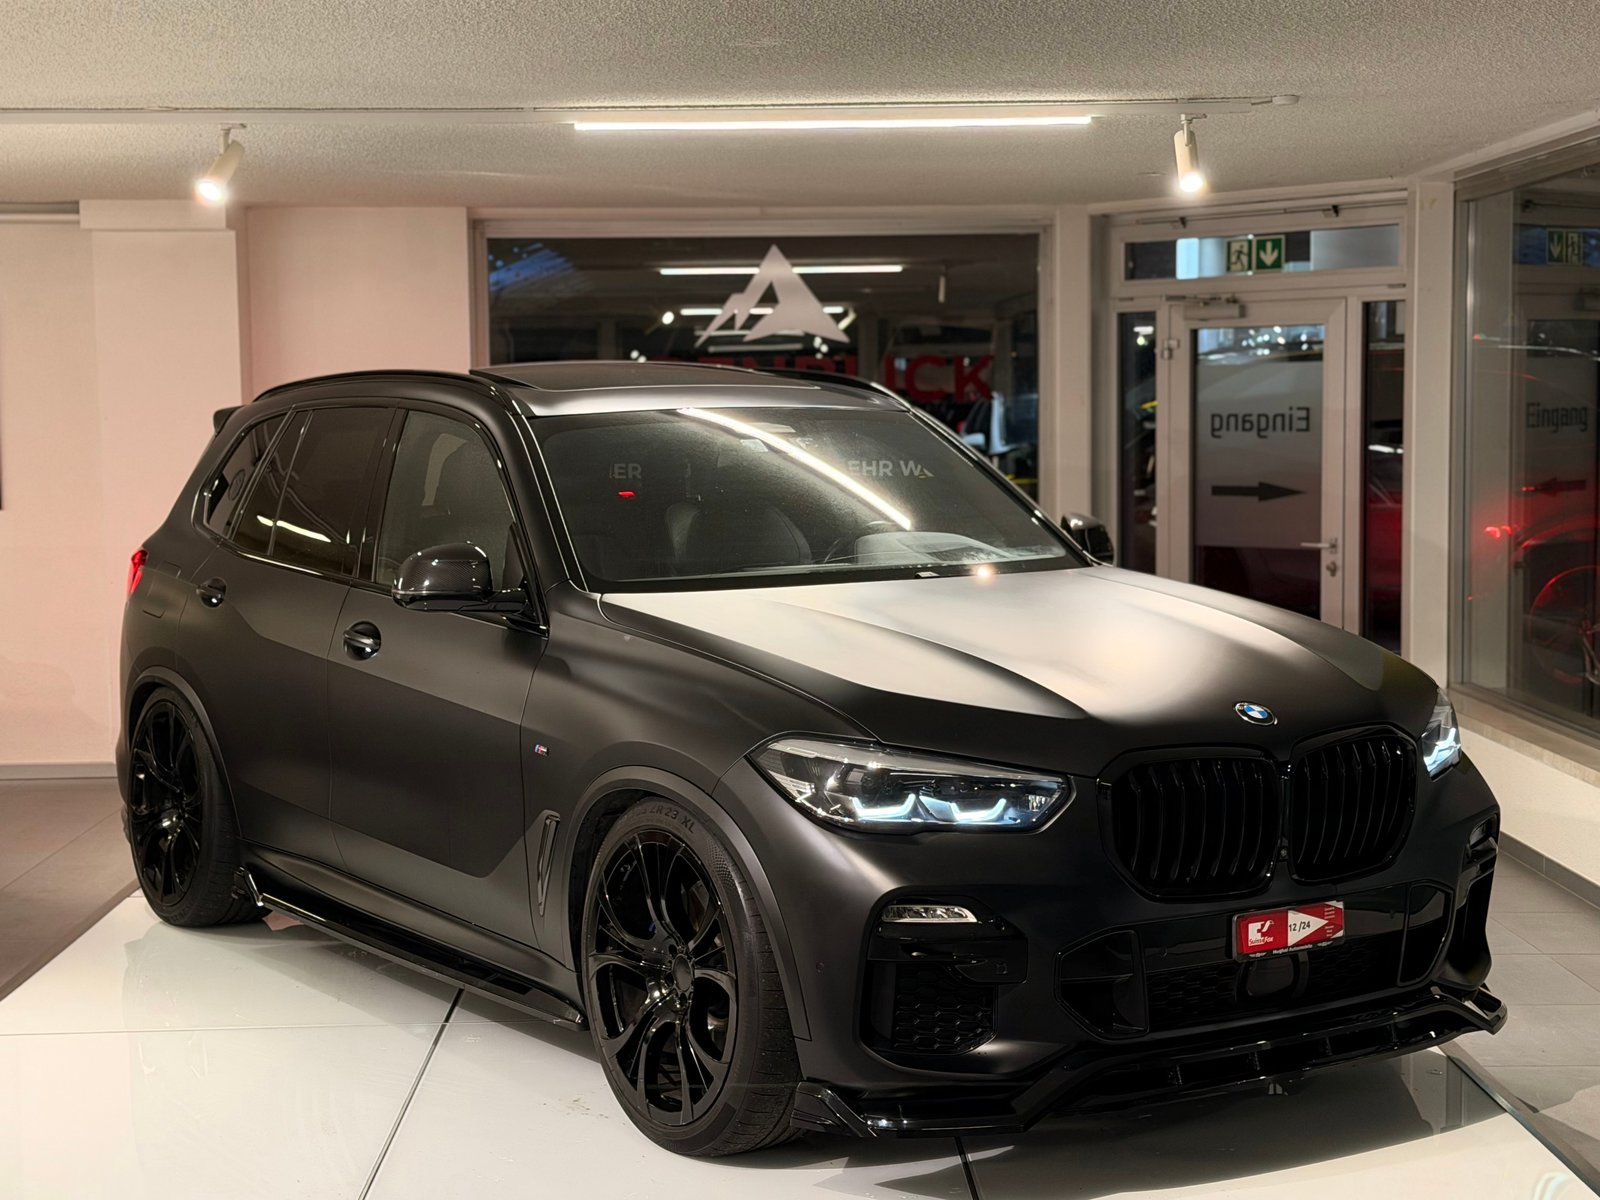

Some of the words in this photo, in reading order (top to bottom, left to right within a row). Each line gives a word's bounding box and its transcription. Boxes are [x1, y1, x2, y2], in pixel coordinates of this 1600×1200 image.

[1526, 402, 1589, 433] Eingang
[609, 463, 642, 479] ER
[681, 816, 695, 833] XL
